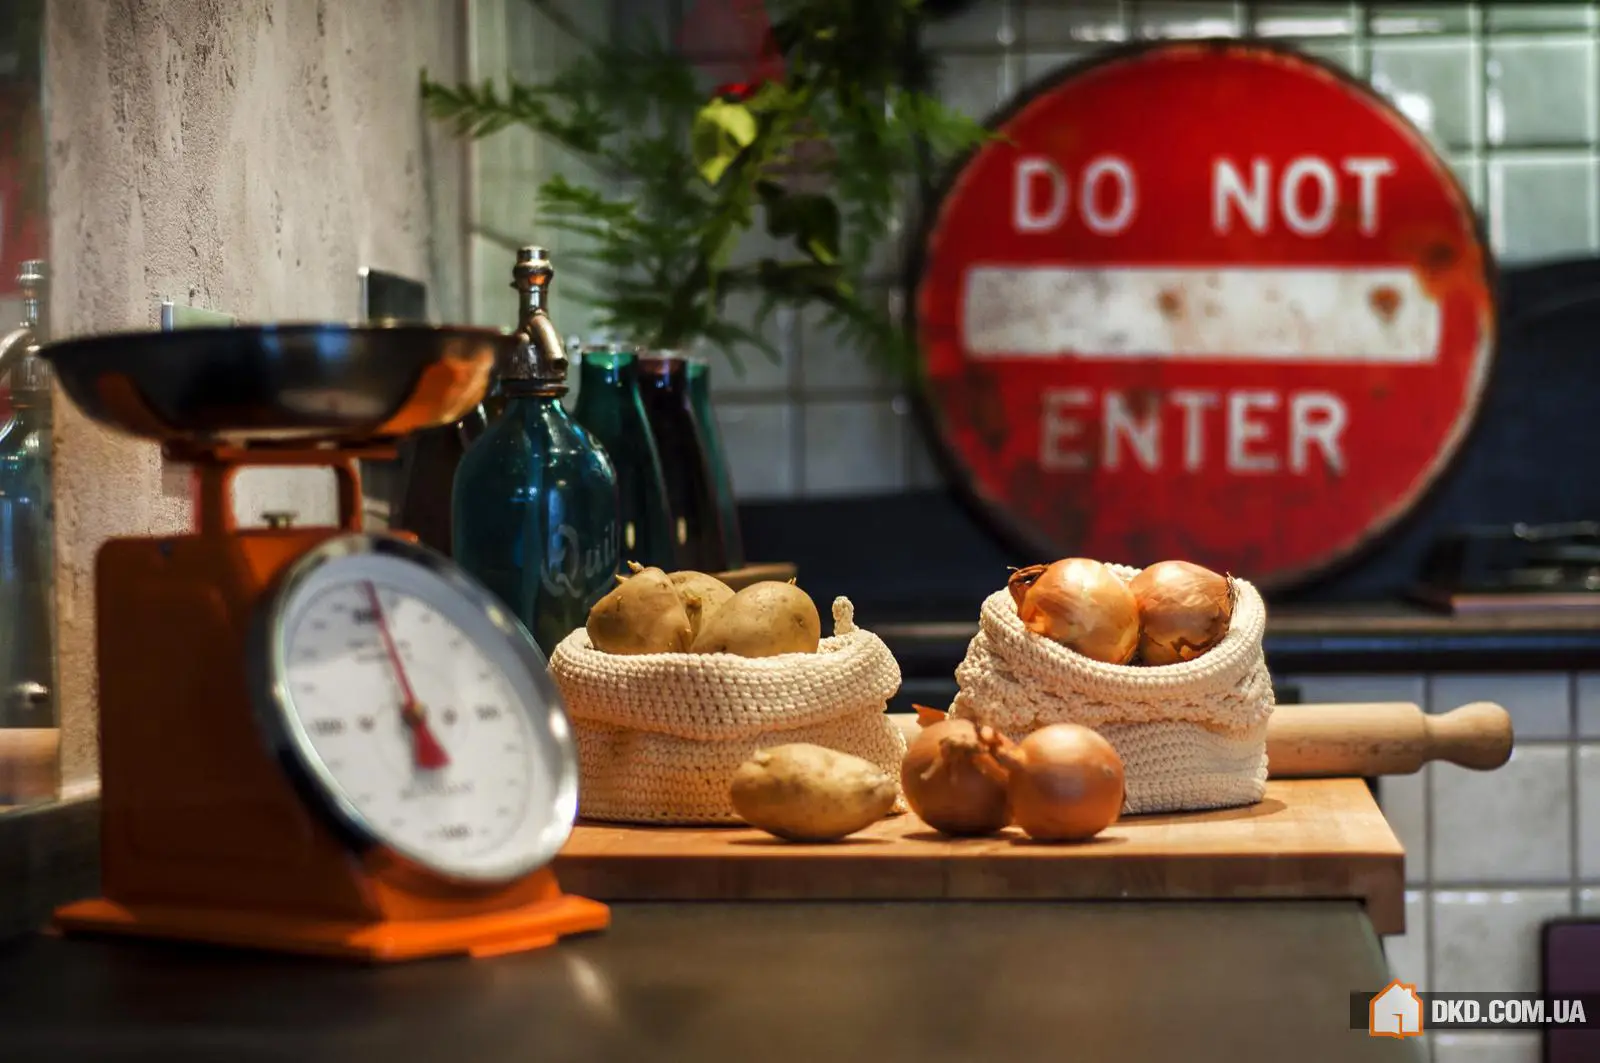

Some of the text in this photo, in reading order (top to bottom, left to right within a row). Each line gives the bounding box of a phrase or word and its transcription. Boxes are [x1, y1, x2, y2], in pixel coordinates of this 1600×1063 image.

[1011, 155, 1395, 236] DO NOT
[1038, 387, 1348, 475] ENTER
